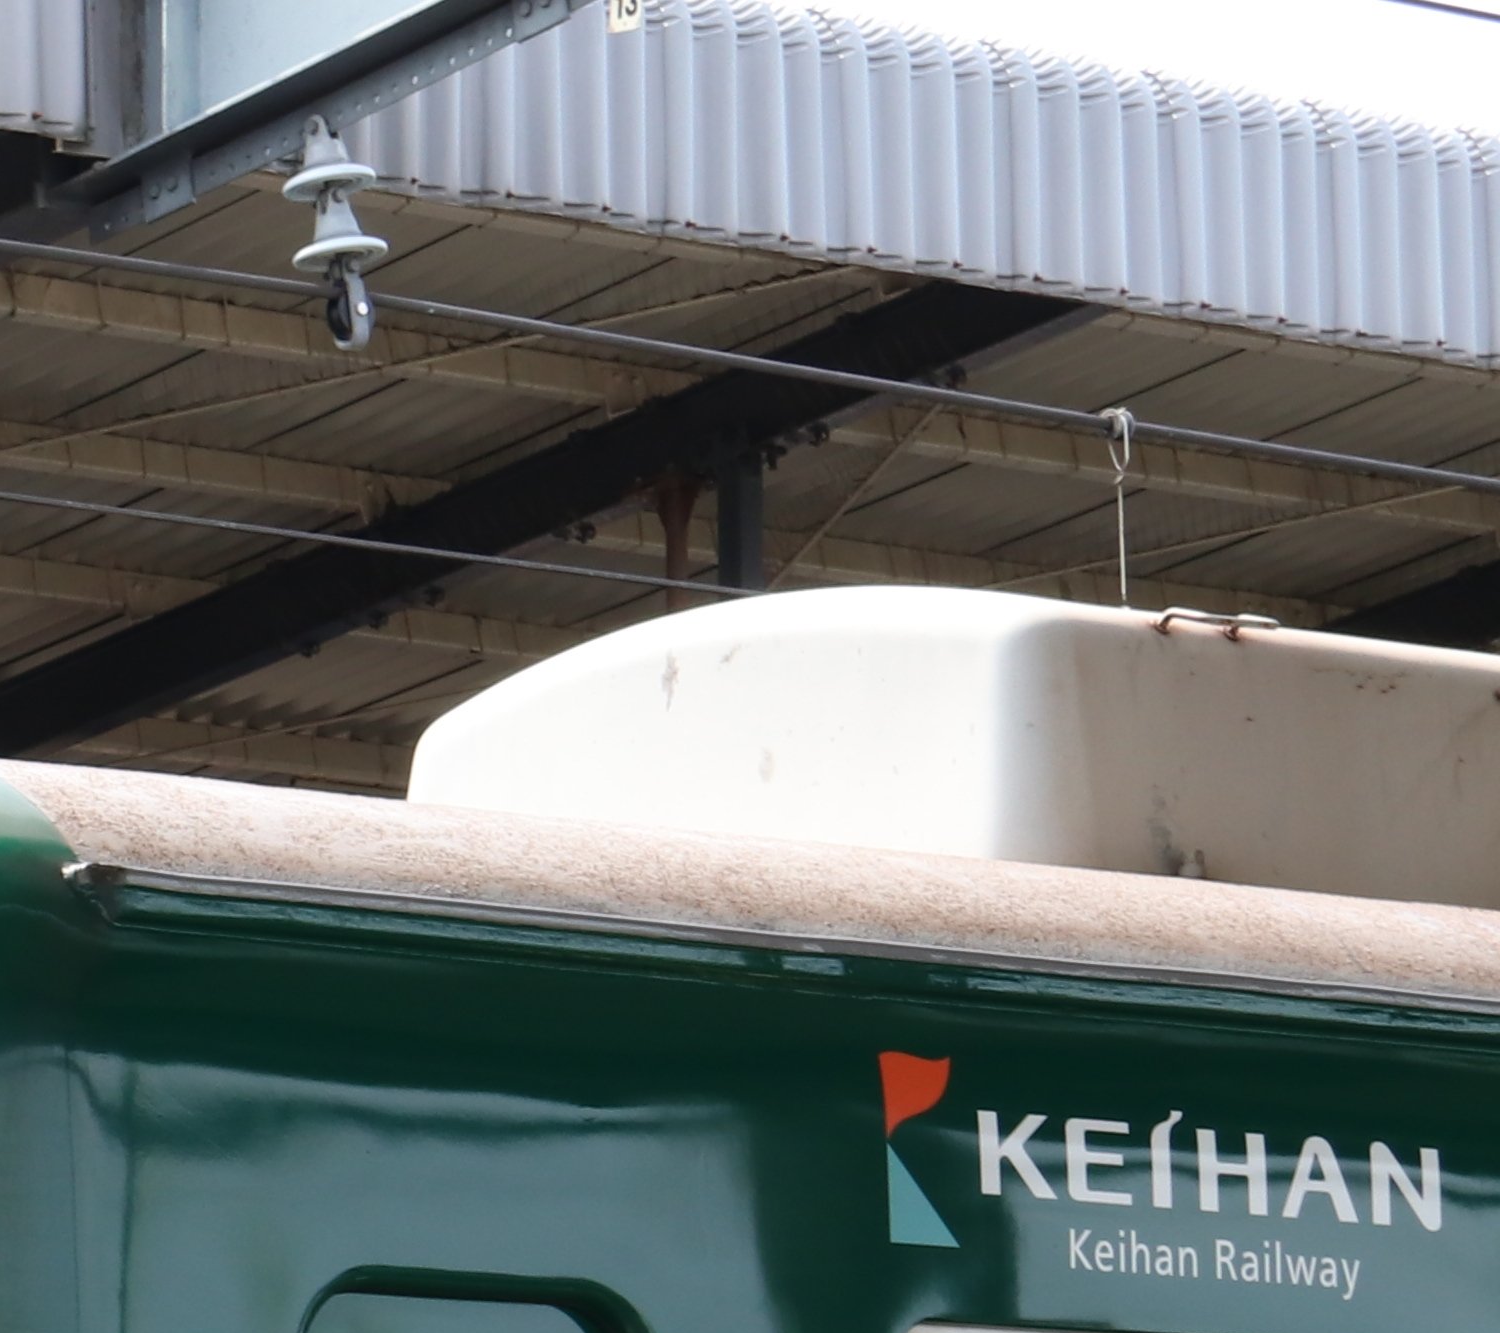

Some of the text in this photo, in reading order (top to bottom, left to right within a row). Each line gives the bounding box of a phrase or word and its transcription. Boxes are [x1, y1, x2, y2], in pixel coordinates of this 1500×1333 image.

[977, 1111, 1441, 1232] KEIHAN
[1069, 1229, 1360, 1300] Keihan Railway
